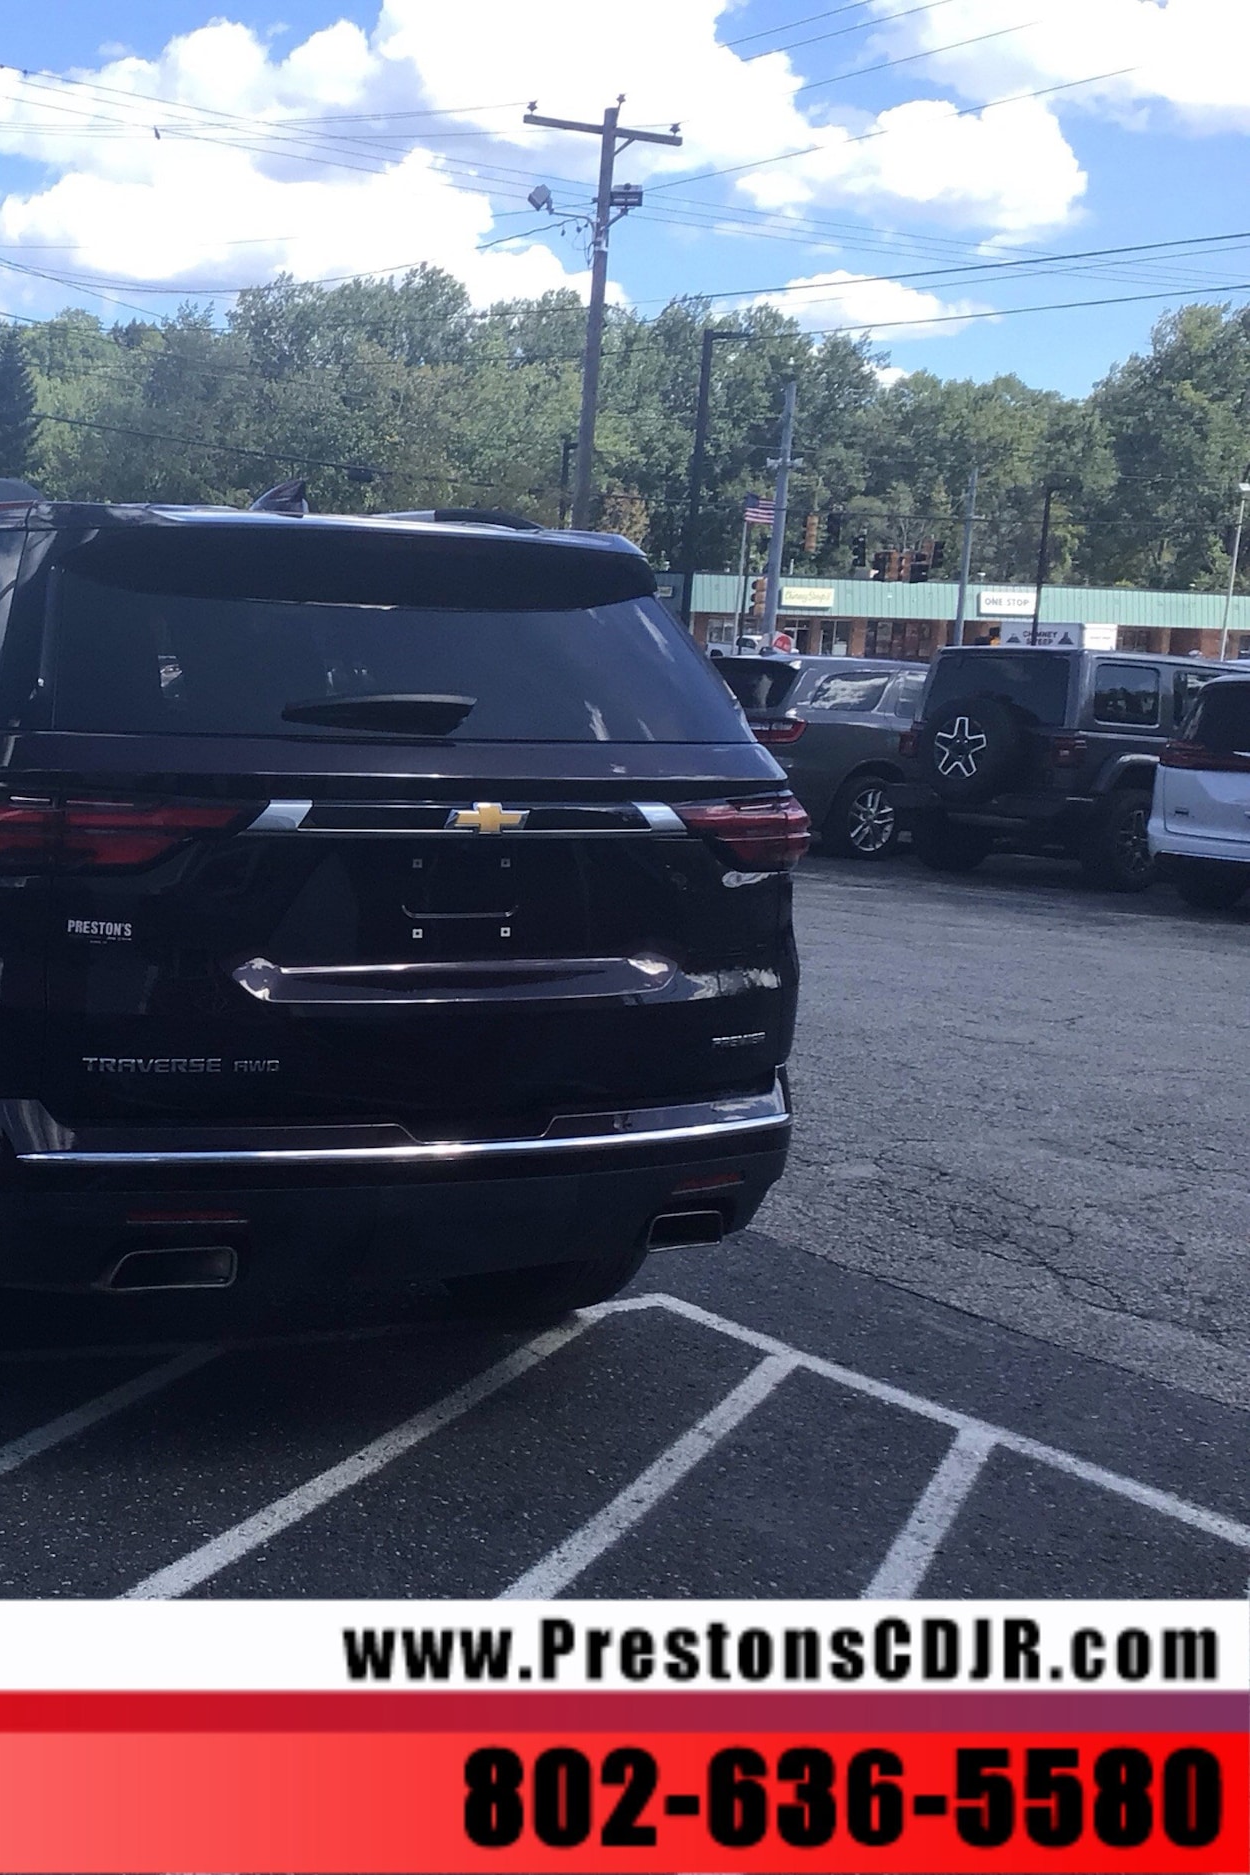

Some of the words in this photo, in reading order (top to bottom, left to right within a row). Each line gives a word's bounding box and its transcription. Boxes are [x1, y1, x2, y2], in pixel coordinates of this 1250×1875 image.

[984, 597, 1003, 606] ONE
[1007, 599, 1030, 607] STOP
[1022, 630, 1058, 638] CHMNEY
[1026, 638, 1054, 646] SEEP
[67, 919, 132, 937] PRESTON'S
[82, 1057, 222, 1073] TRAVERSE
[233, 1059, 280, 1073] AWD
